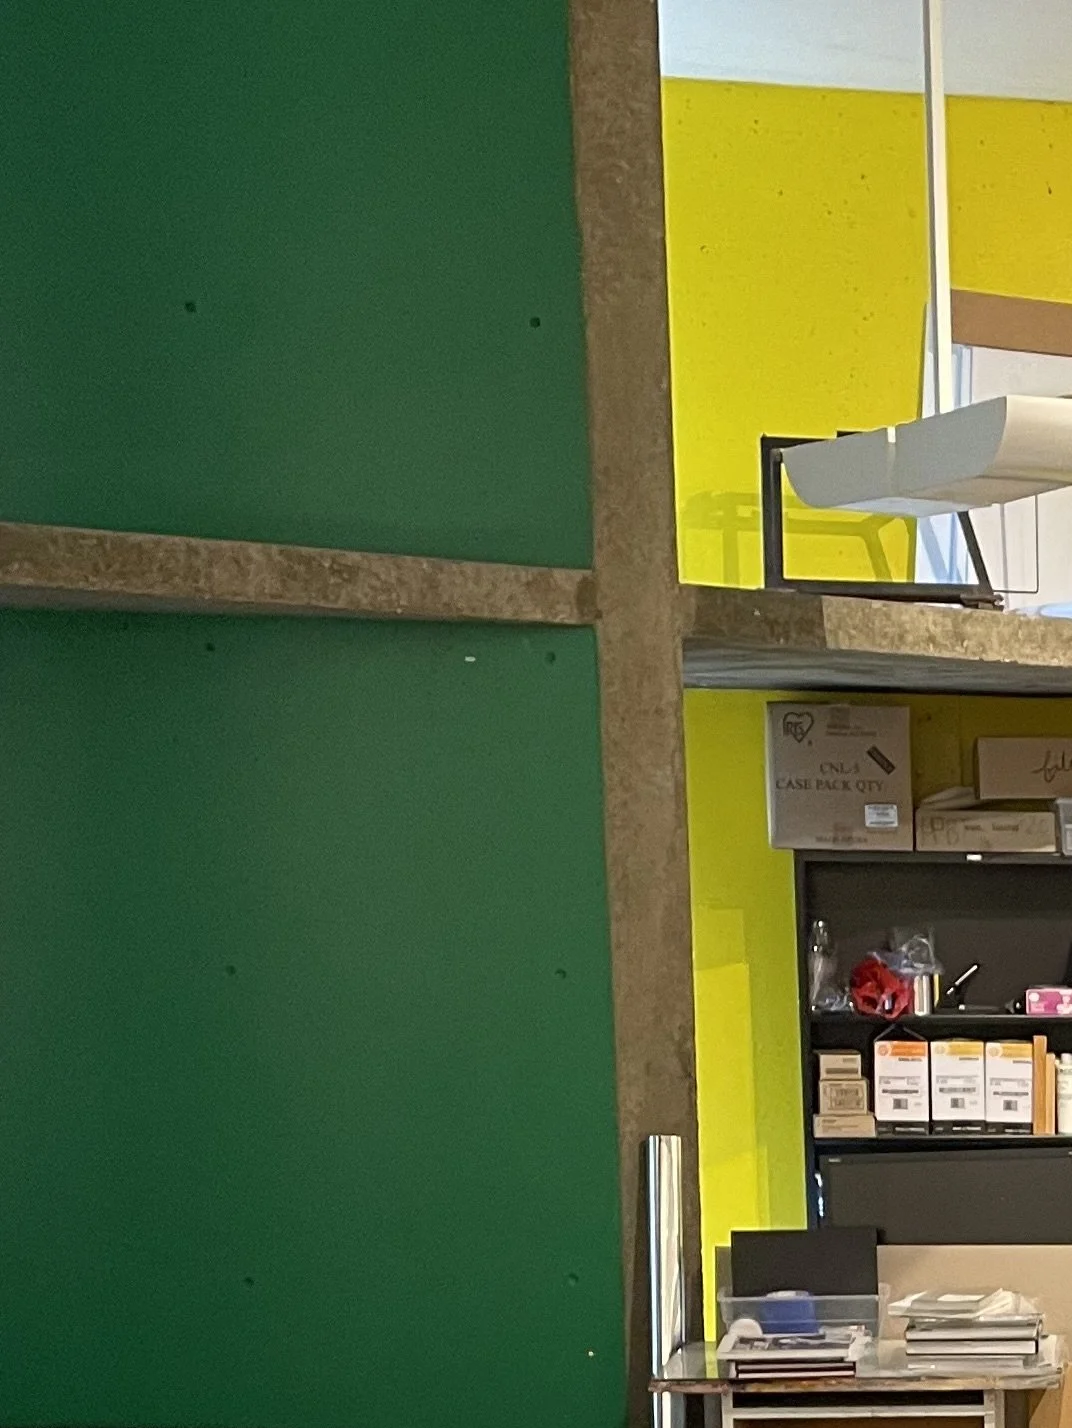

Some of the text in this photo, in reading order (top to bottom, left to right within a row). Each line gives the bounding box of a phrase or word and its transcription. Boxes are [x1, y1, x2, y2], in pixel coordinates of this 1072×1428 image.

[775, 778, 884, 793] CASE PACK QTY
